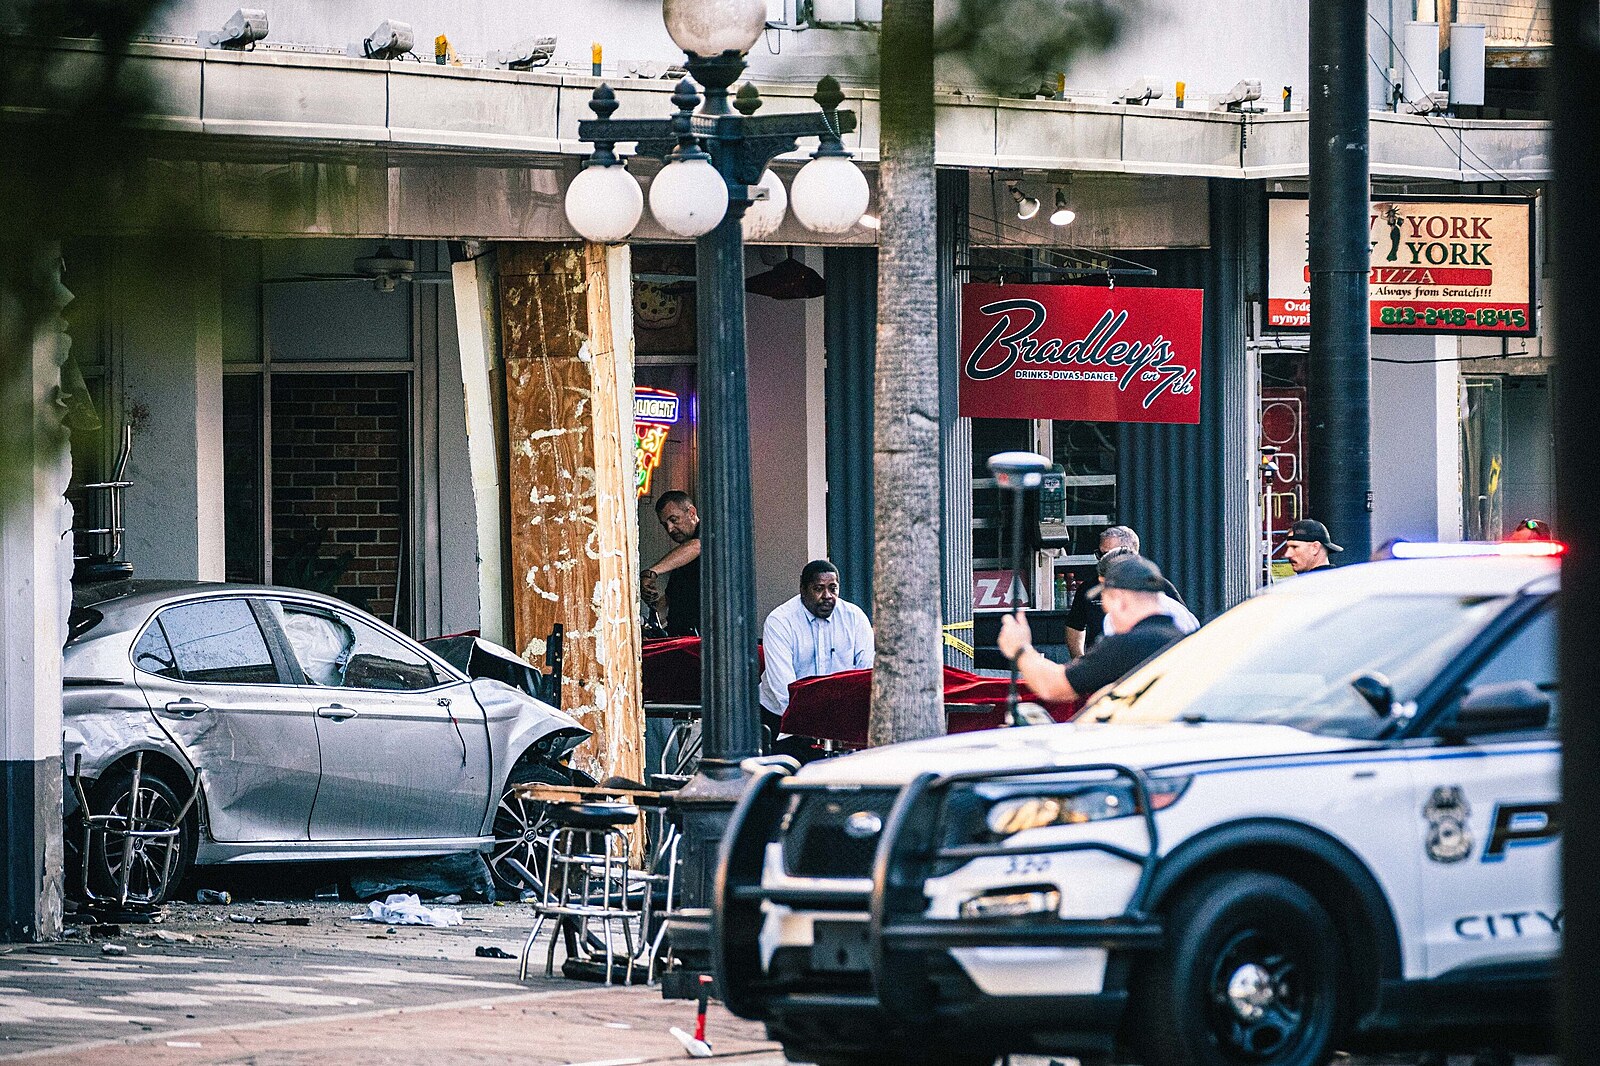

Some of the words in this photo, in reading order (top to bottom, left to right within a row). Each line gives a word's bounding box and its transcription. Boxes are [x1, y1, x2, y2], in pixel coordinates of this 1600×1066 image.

[1406, 215, 1493, 239] YORK
[1405, 242, 1493, 265] YORK
[1375, 285, 1411, 300] Always
[1413, 286, 1439, 300] from
[1442, 287, 1492, 298] Scratch!!!
[1284, 301, 1310, 312] Orde
[1380, 306, 1526, 328] 813-248-1845
[1272, 313, 1310, 325] nynypi
[965, 298, 1175, 391] Bradley's
[1141, 371, 1160, 382] on
[1142, 365, 1197, 409] 7th
[636, 399, 676, 418] LIGHT
[973, 575, 1029, 605] ZA
[1454, 909, 1565, 940] CITY
